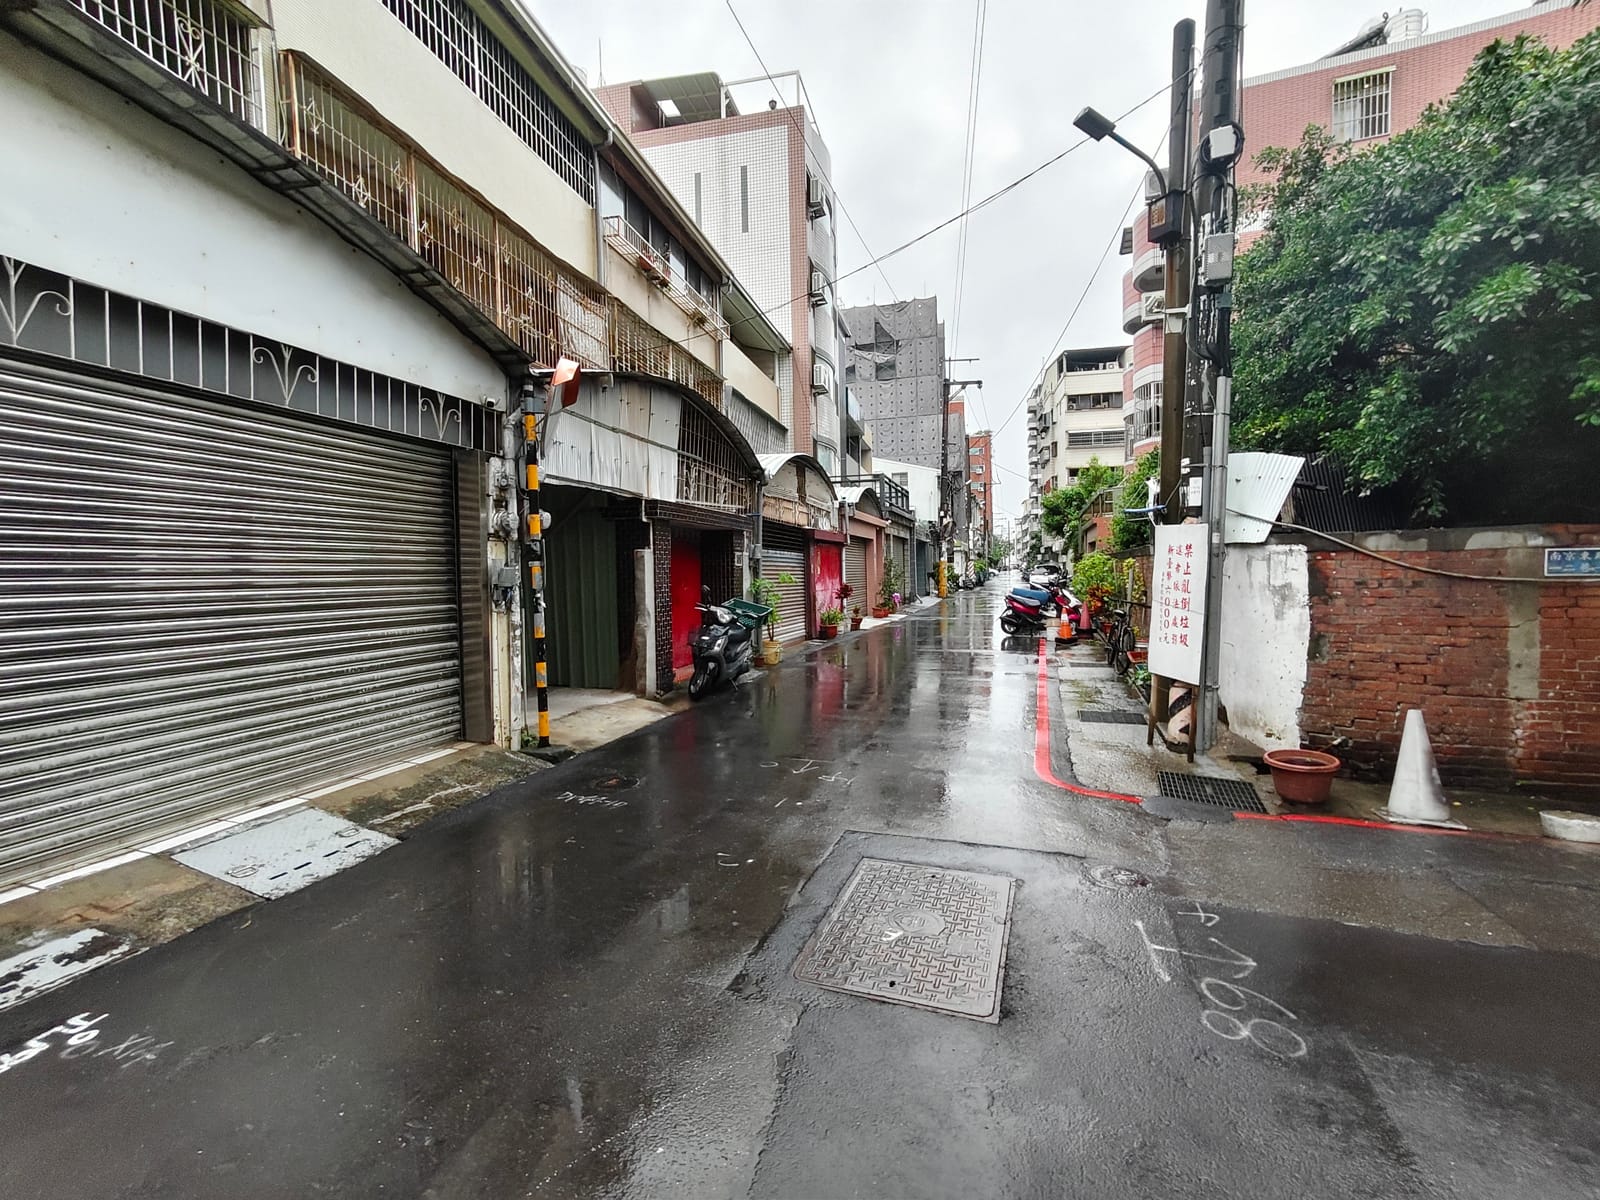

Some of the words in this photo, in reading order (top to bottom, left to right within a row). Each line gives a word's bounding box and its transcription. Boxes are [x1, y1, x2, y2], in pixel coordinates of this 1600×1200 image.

[1180, 543, 1193, 647] 禁止亂倒垃圾
